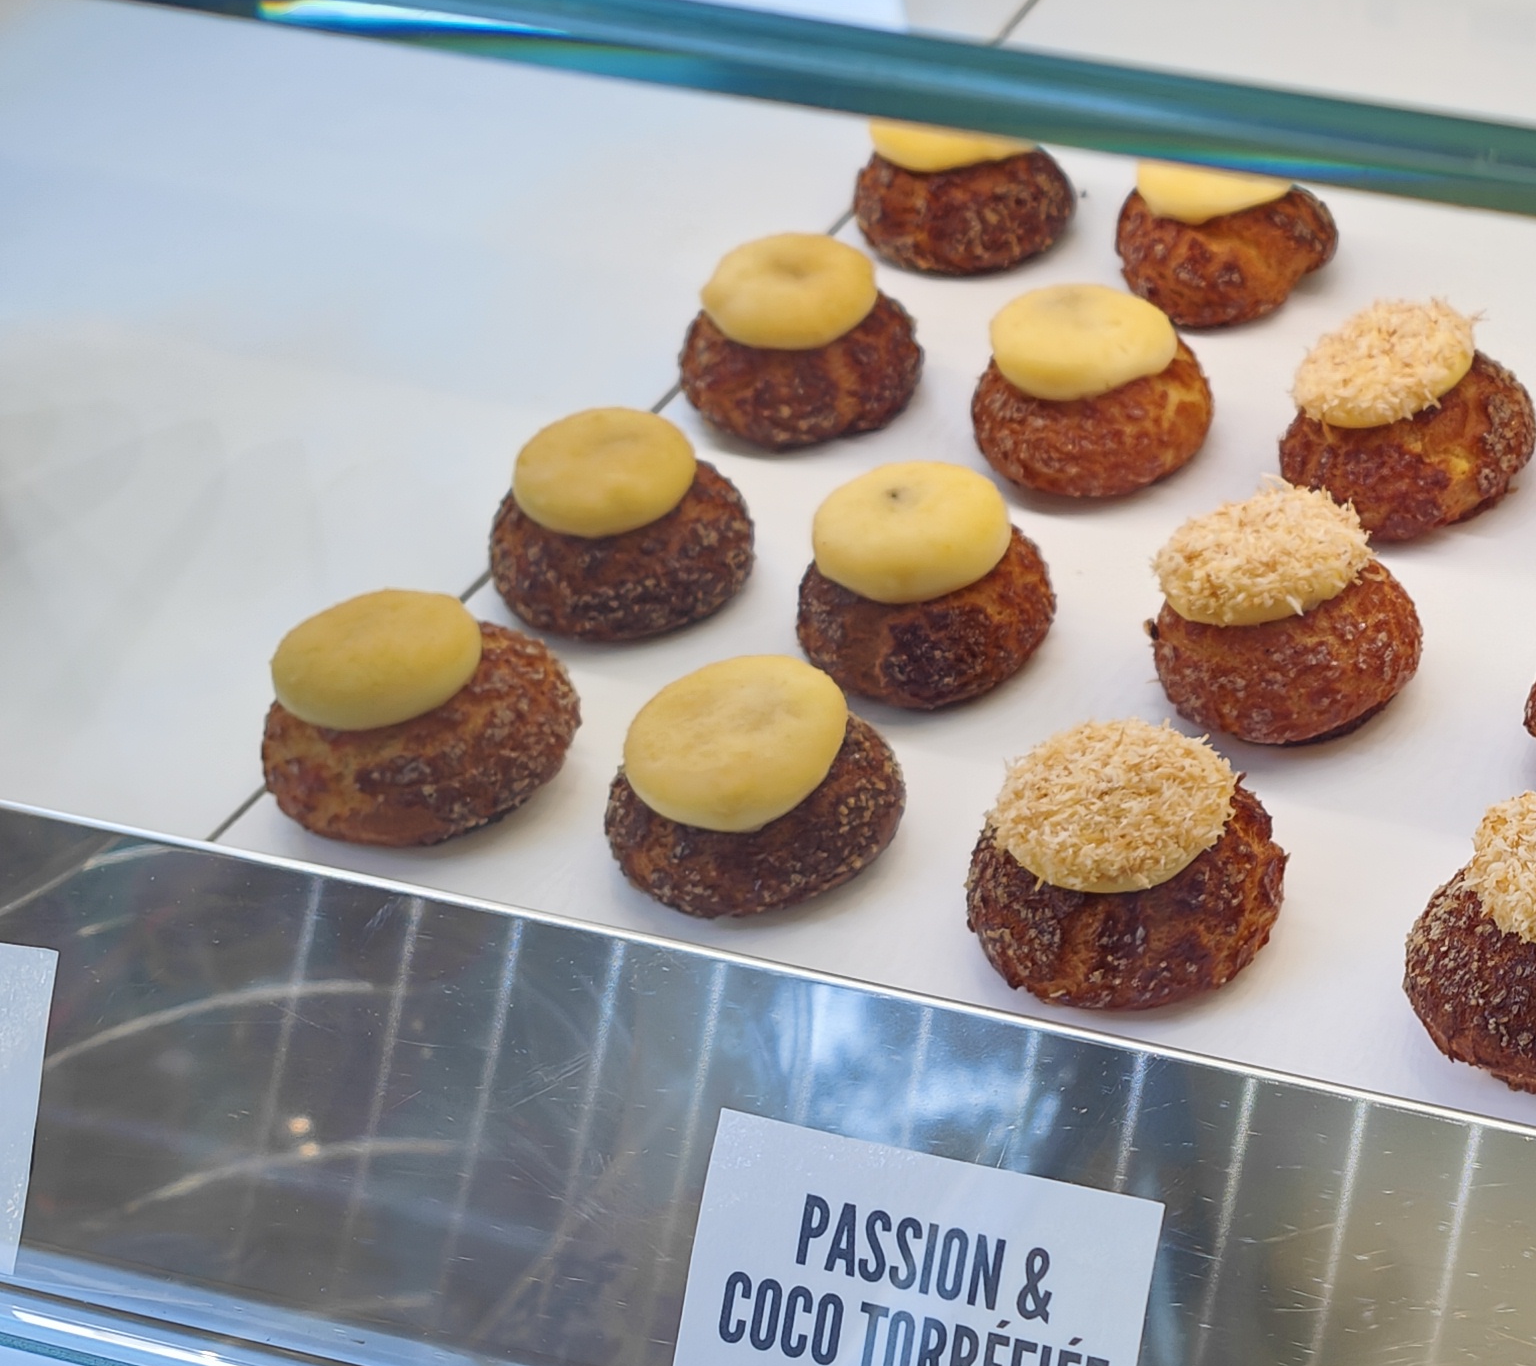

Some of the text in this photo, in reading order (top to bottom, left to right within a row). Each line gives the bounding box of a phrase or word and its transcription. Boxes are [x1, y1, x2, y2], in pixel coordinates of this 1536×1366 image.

[795, 1193, 1053, 1324] PASSION &
[718, 1271, 845, 1366] COCO
